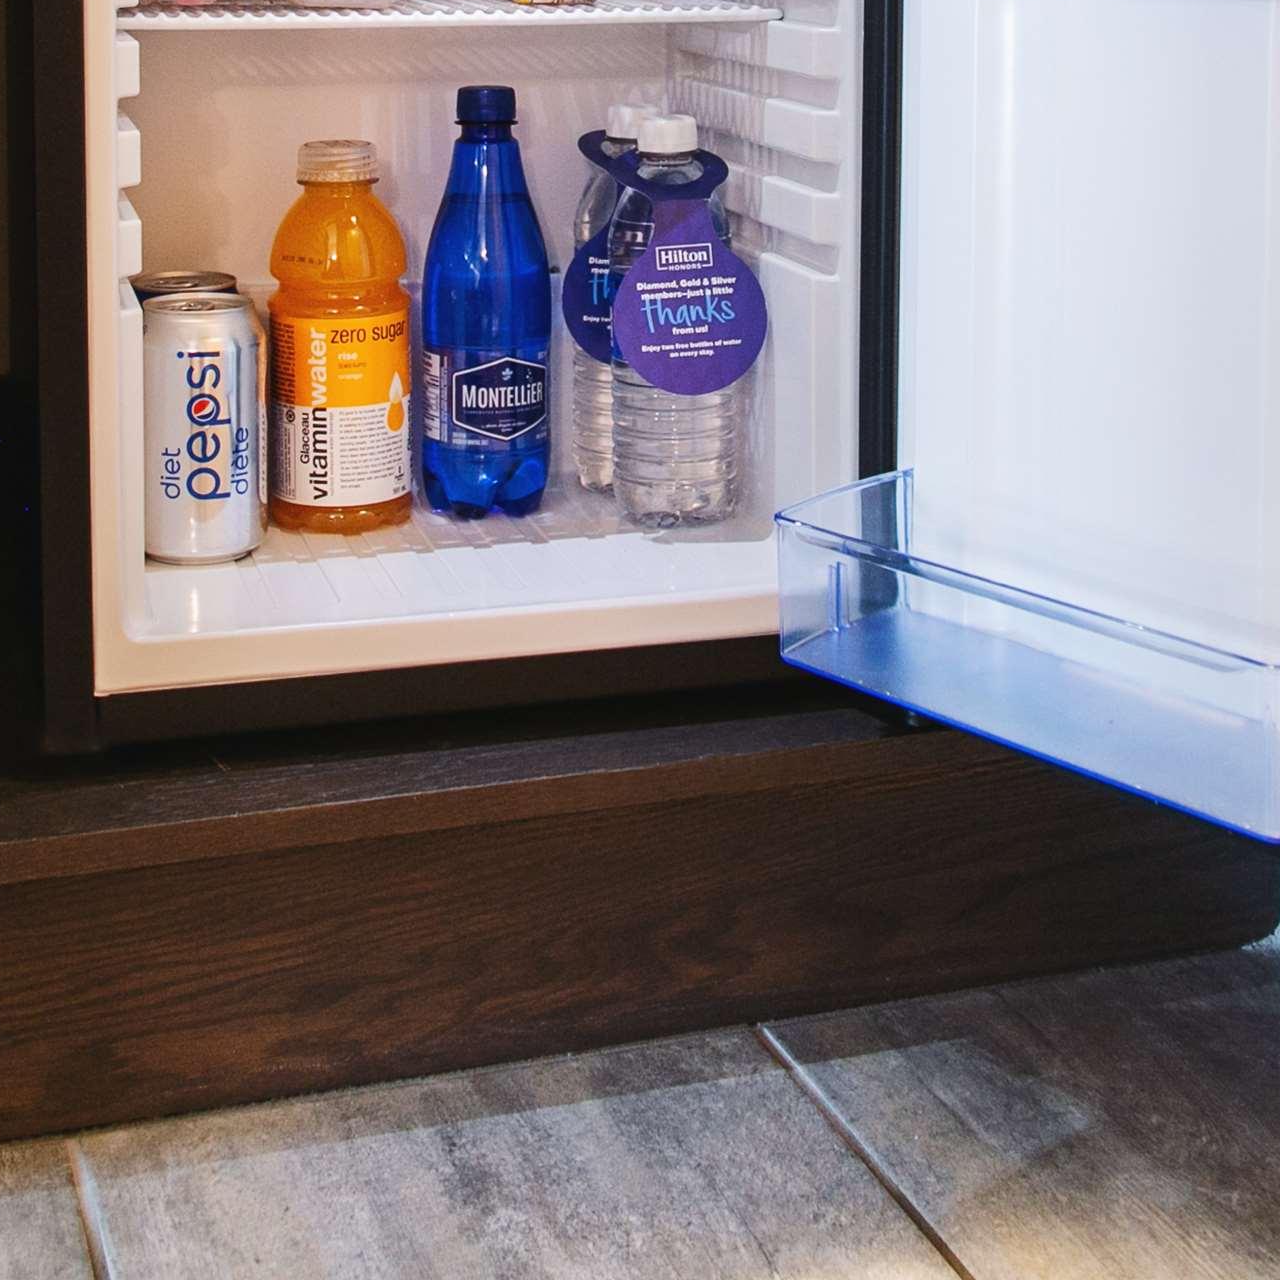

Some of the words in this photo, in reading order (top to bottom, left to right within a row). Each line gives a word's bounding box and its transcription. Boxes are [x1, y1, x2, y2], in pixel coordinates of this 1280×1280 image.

[660, 250, 708, 265] Hilton
[668, 263, 702, 271] HONORS
[636, 280, 679, 291] Diamond,
[680, 278, 701, 288] Gold
[702, 277, 711, 286] &
[711, 276, 737, 286] Silver
[712, 286, 734, 296] little
[330, 327, 366, 344] zero
[371, 320, 406, 342] sugar
[671, 326, 694, 336] from
[695, 324, 709, 334] us!
[641, 344, 661, 353] Enjoy
[661, 343, 675, 351] two
[675, 341, 689, 350] free
[689, 340, 714, 349] bottles
[714, 338, 722, 347] of
[723, 338, 742, 346] water
[679, 350, 699, 358] every
[177, 350, 232, 501] pepsi
[160, 447, 181, 500] diet
